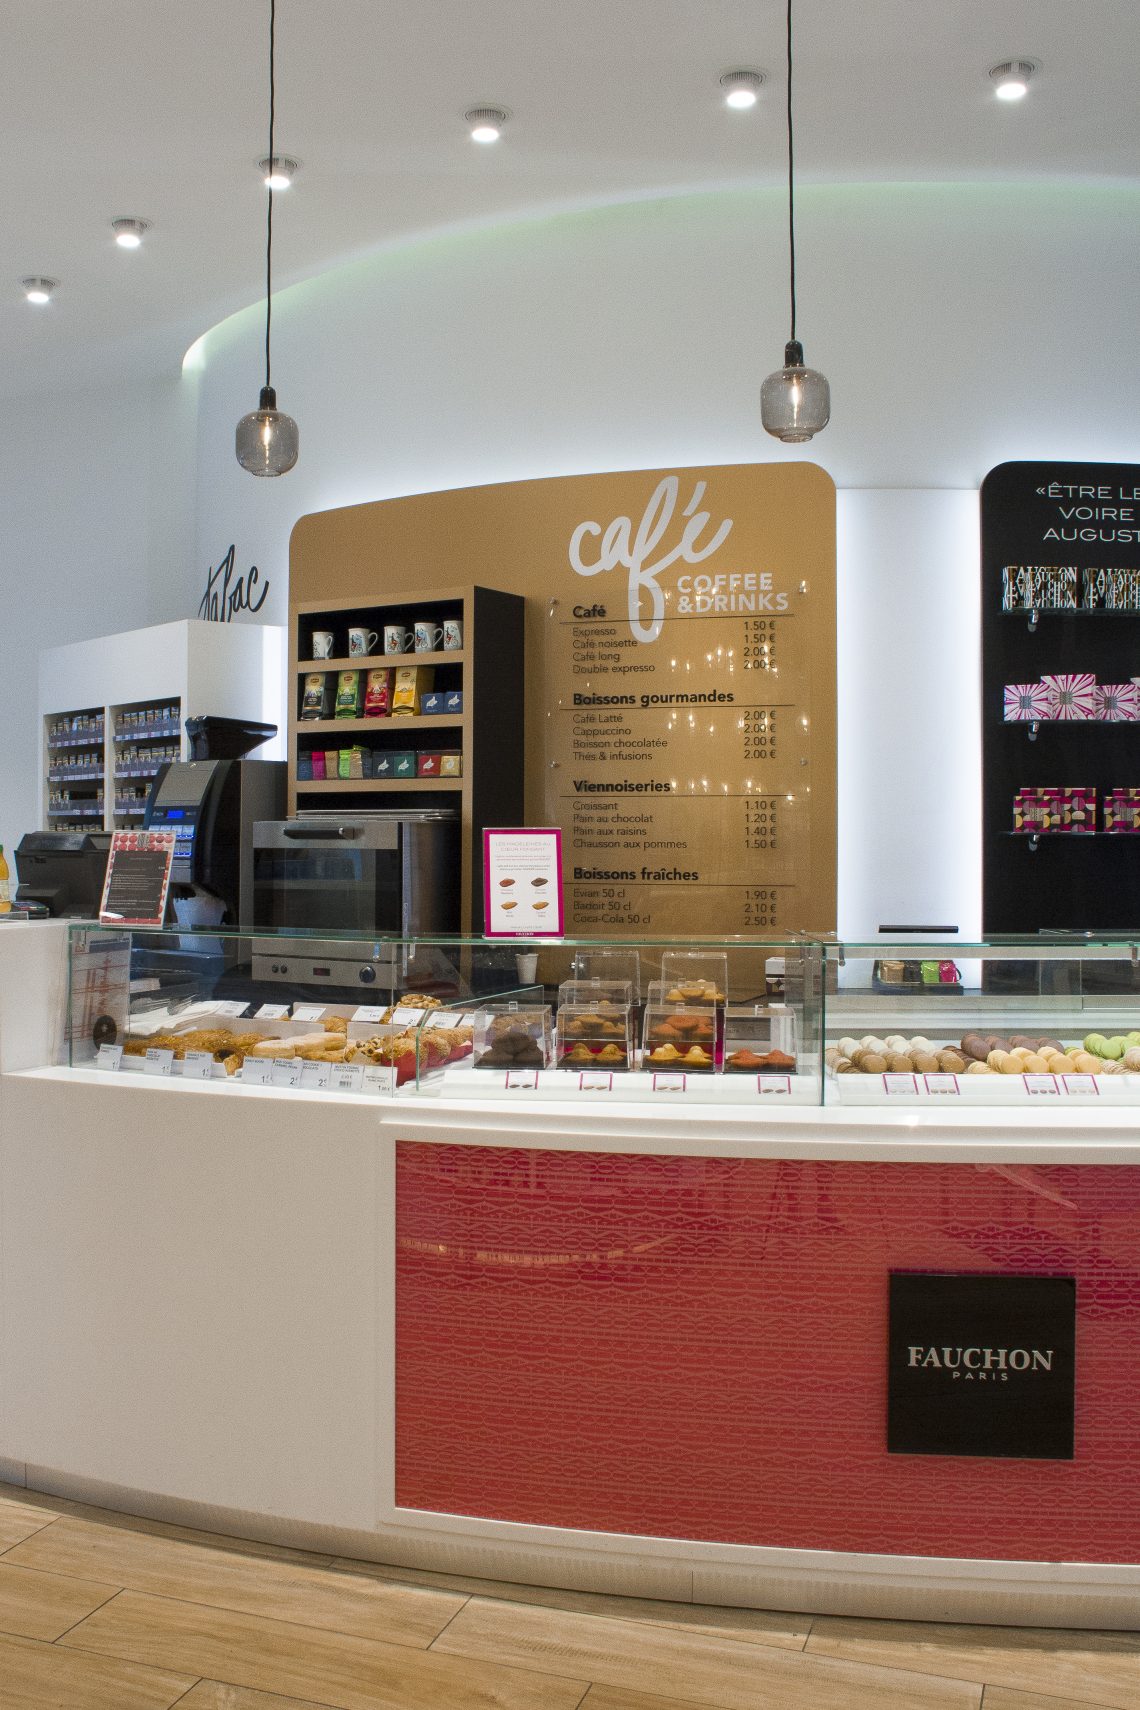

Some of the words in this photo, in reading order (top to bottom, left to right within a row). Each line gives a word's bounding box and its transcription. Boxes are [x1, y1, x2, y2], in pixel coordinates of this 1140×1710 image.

[1059, 506, 1135, 521] VOIRE
[569, 475, 733, 644] café
[677, 573, 773, 594] COFFEE
[677, 592, 789, 614] &DRINKS
[573, 605, 606, 618] Café
[573, 627, 617, 639] Expresso
[744, 621, 766, 630] 1.50
[573, 640, 595, 649] Café
[597, 639, 638, 648] noisette
[744, 633, 766, 643] 1.50
[573, 652, 595, 661] Café
[598, 652, 620, 662] long
[744, 647, 766, 656] 2.00
[573, 664, 608, 674] Double
[611, 664, 655, 675] expresso
[573, 693, 636, 705] Boissons
[641, 689, 734, 708] gourmandes
[573, 714, 595, 724] Café
[599, 713, 623, 723] Latté
[744, 710, 766, 720] 2.00
[573, 726, 632, 738] Cappuccino
[744, 724, 766, 733] 2.00
[573, 739, 610, 749] Boisson
[613, 738, 668, 748] chocolatée
[744, 736, 766, 746] 2.00
[573, 752, 596, 761] Thés
[598, 752, 606, 761] &
[609, 751, 653, 760] infusions
[744, 749, 766, 759] 2.00
[573, 780, 671, 792] Viennoiseries
[573, 801, 618, 811] Croissant
[745, 800, 767, 810] 1.10
[573, 814, 593, 823] Pain
[596, 815, 608, 823] au
[611, 813, 654, 823] chocolat
[745, 813, 767, 823] 1.20
[573, 826, 593, 836] Pain
[596, 828, 615, 836] aux
[616, 827, 647, 836] raisins
[745, 827, 767, 836] 1.40
[573, 839, 620, 849] Chausson
[623, 840, 641, 849] aux
[643, 840, 687, 851] pommes
[745, 839, 767, 849] 1.50
[573, 867, 636, 880] Boissons
[641, 867, 699, 881] fraîches
[573, 888, 599, 898] Evian
[602, 888, 615, 898] 50
[617, 889, 625, 898] cl
[745, 890, 767, 900] 1.90
[573, 901, 605, 911] Badoit
[608, 902, 620, 911] 50
[623, 902, 631, 911] cl
[745, 904, 767, 913] 2.10
[573, 913, 624, 924] Coca-Cola
[627, 915, 640, 924] 50
[642, 915, 651, 924] cl
[745, 916, 767, 926] 2.50
[908, 1346, 1054, 1371] FAUCHON
[953, 1371, 1008, 1381] PARIS
